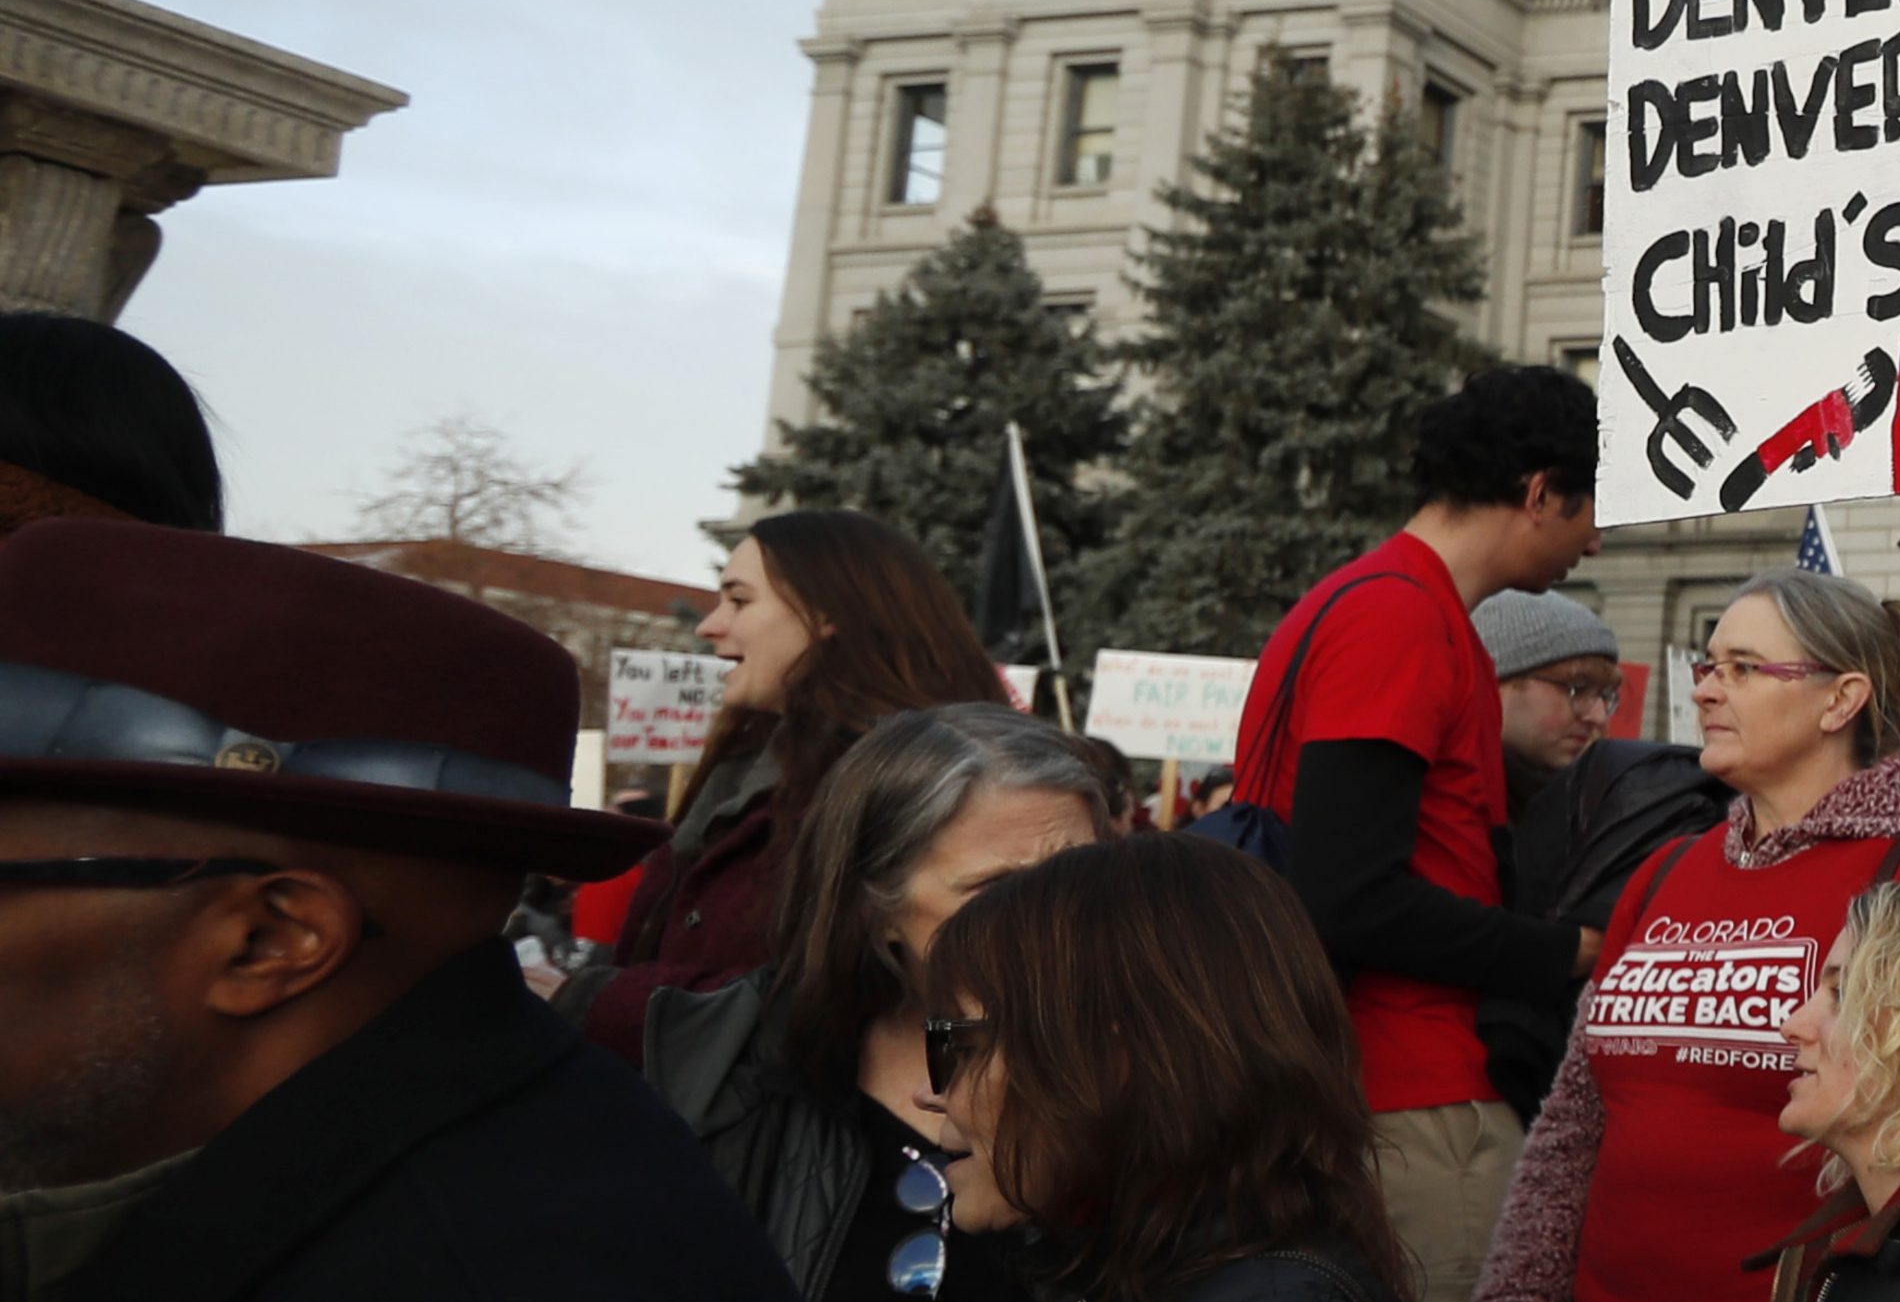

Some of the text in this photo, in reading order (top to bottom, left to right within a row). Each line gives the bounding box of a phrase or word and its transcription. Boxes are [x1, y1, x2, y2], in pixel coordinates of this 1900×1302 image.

[616, 655, 650, 681] You
[663, 657, 704, 683] left
[1132, 679, 1189, 708] FAIR
[614, 697, 645, 721] You
[1645, 915, 1795, 945] COLORADO
[1687, 950, 1716, 962] THE
[1599, 959, 1801, 993] Educators
[1694, 996, 1799, 1028] BACK
